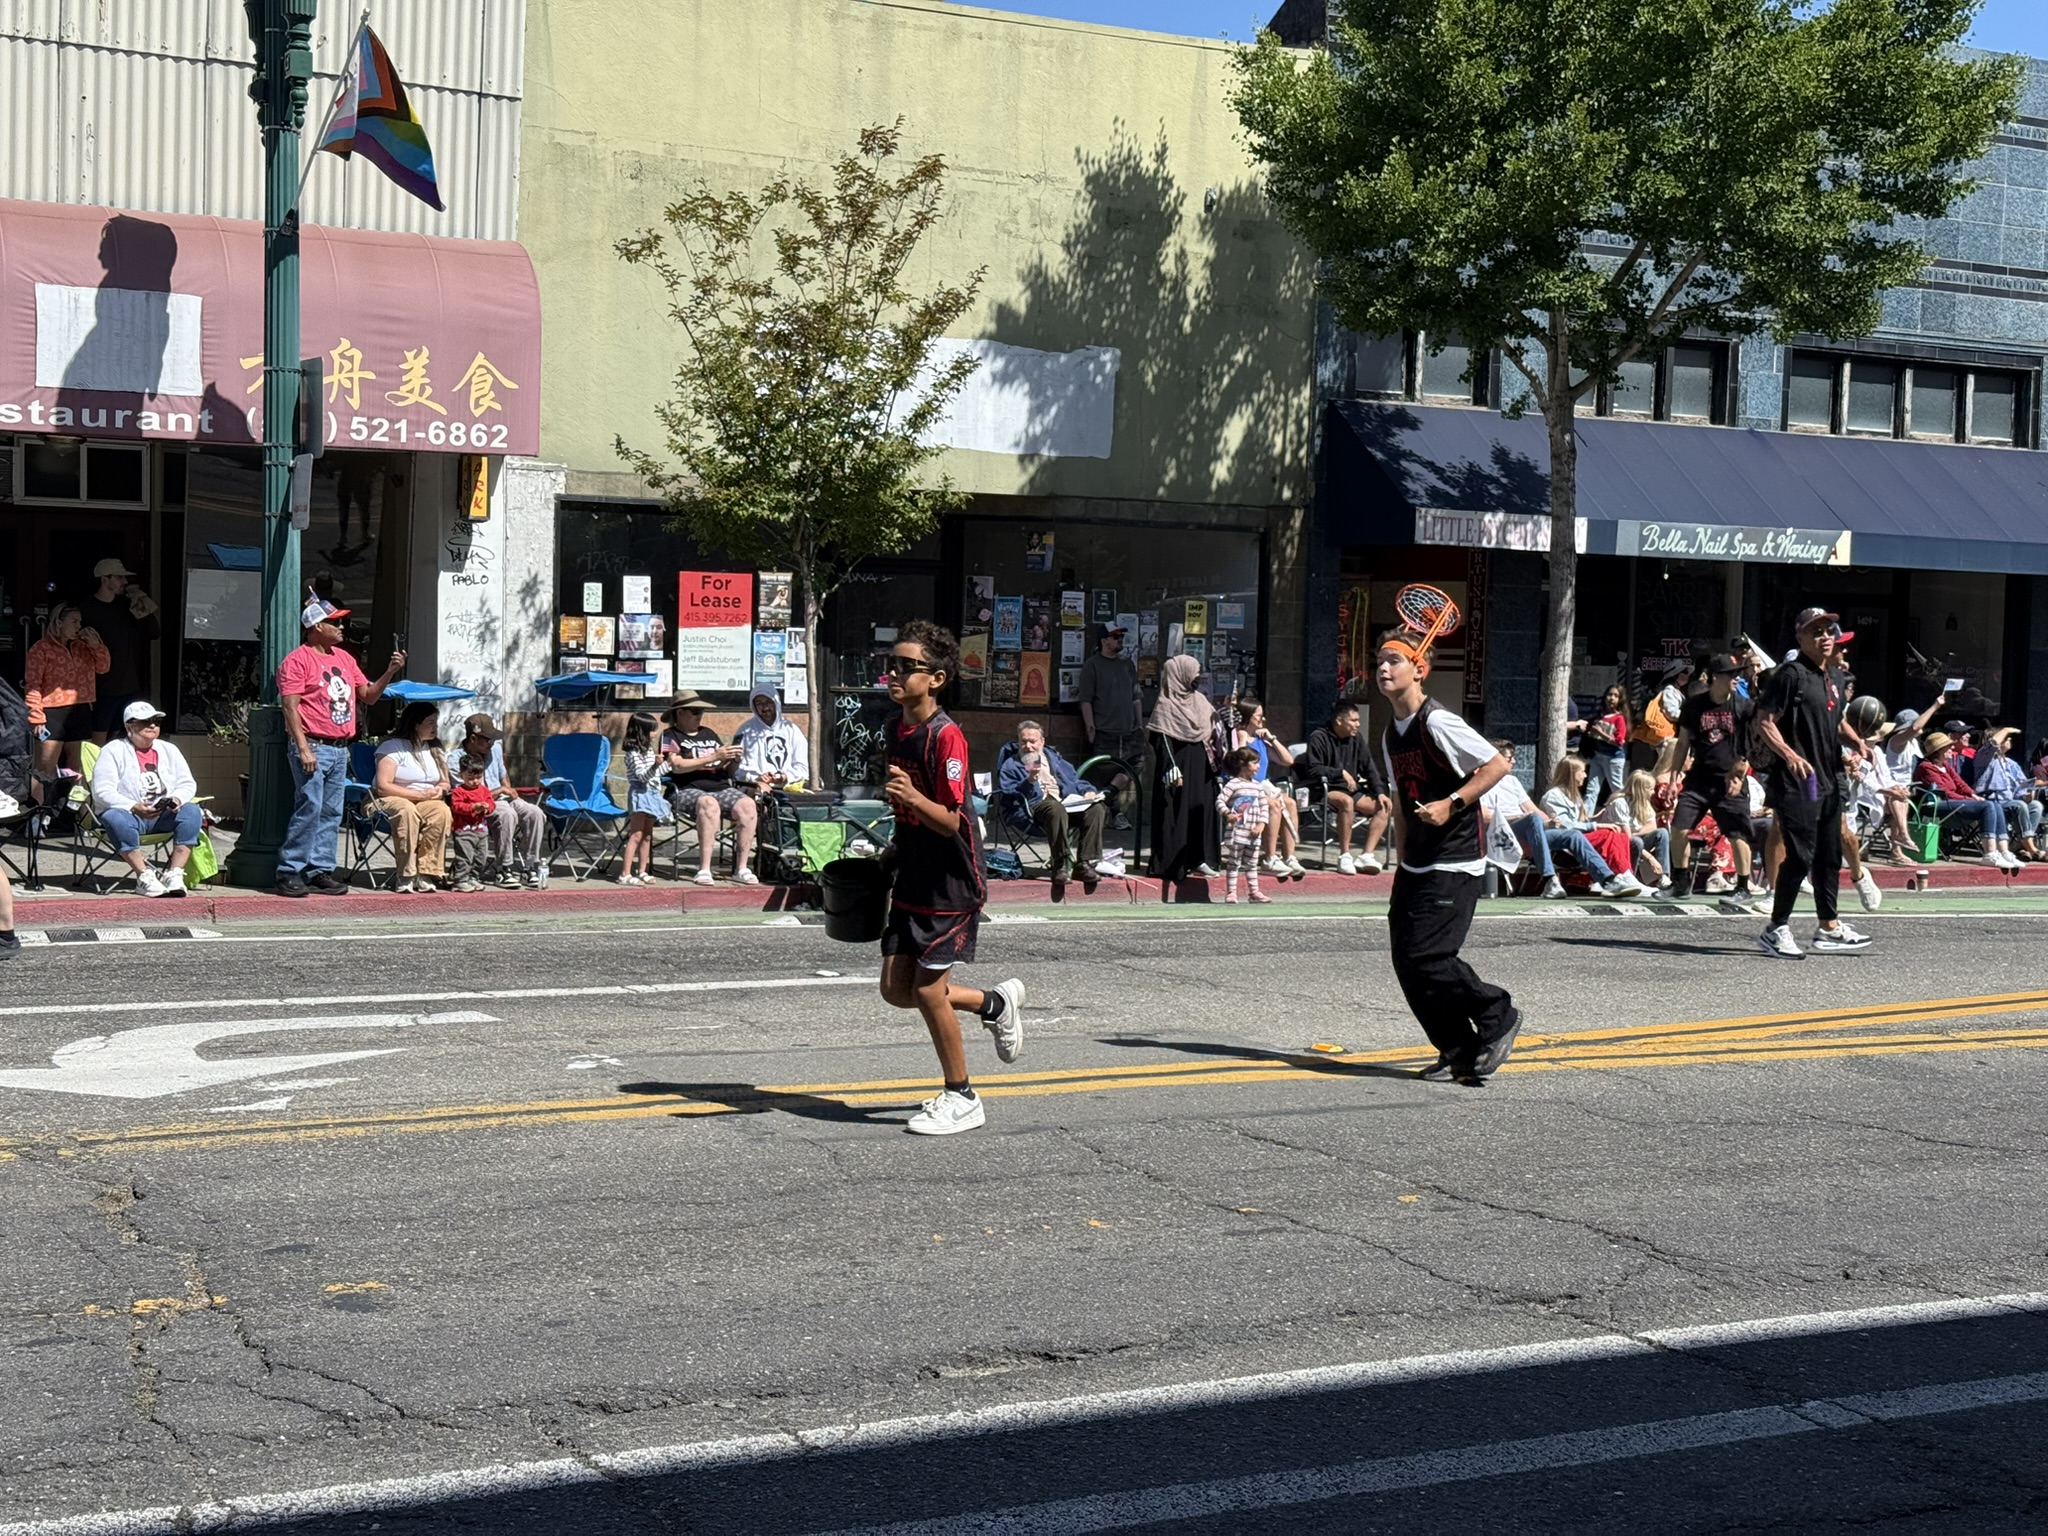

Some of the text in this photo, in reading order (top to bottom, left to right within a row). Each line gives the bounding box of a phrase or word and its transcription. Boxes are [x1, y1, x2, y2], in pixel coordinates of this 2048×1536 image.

[349, 416, 509, 448] 521-6862
[1642, 524, 1828, 564] Bella Nail Spa & Waxing
[452, 574, 489, 586] PABLO
[701, 575, 732, 590] For
[690, 592, 741, 608] Lease
[684, 612, 748, 623] 415.395.7262
[682, 635, 727, 643] Justin Choi
[1661, 638, 1691, 656] TK
[681, 655, 697, 663] Jeff
[1469, 630, 1481, 692] TELLER
